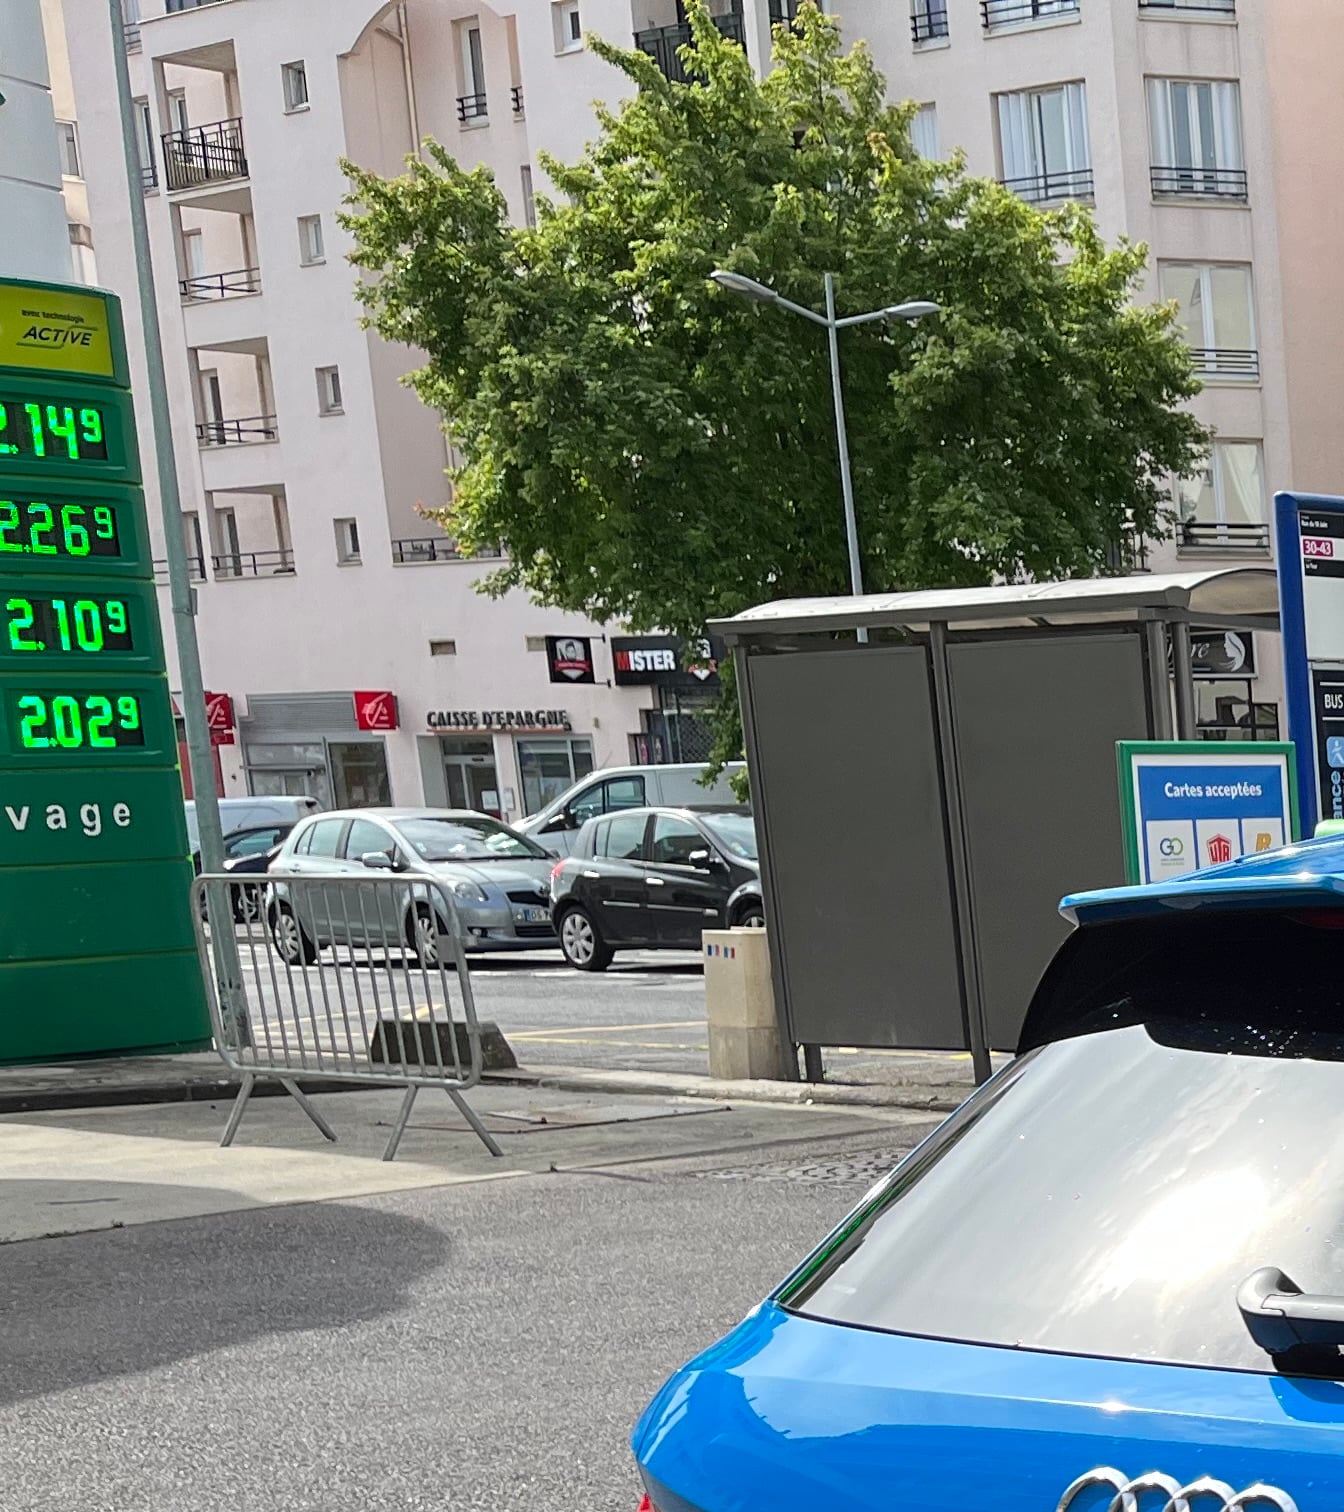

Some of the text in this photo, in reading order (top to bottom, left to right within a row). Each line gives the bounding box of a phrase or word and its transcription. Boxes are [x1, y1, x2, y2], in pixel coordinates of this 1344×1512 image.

[23, 326, 92, 346] ACTIVE
[1304, 540, 1333, 556] 30-43
[616, 649, 676, 672] MISTER
[1324, 693, 1344, 709] BUS
[426, 710, 479, 728] CAISSE
[1164, 781, 1263, 800] Cartes acceptées
